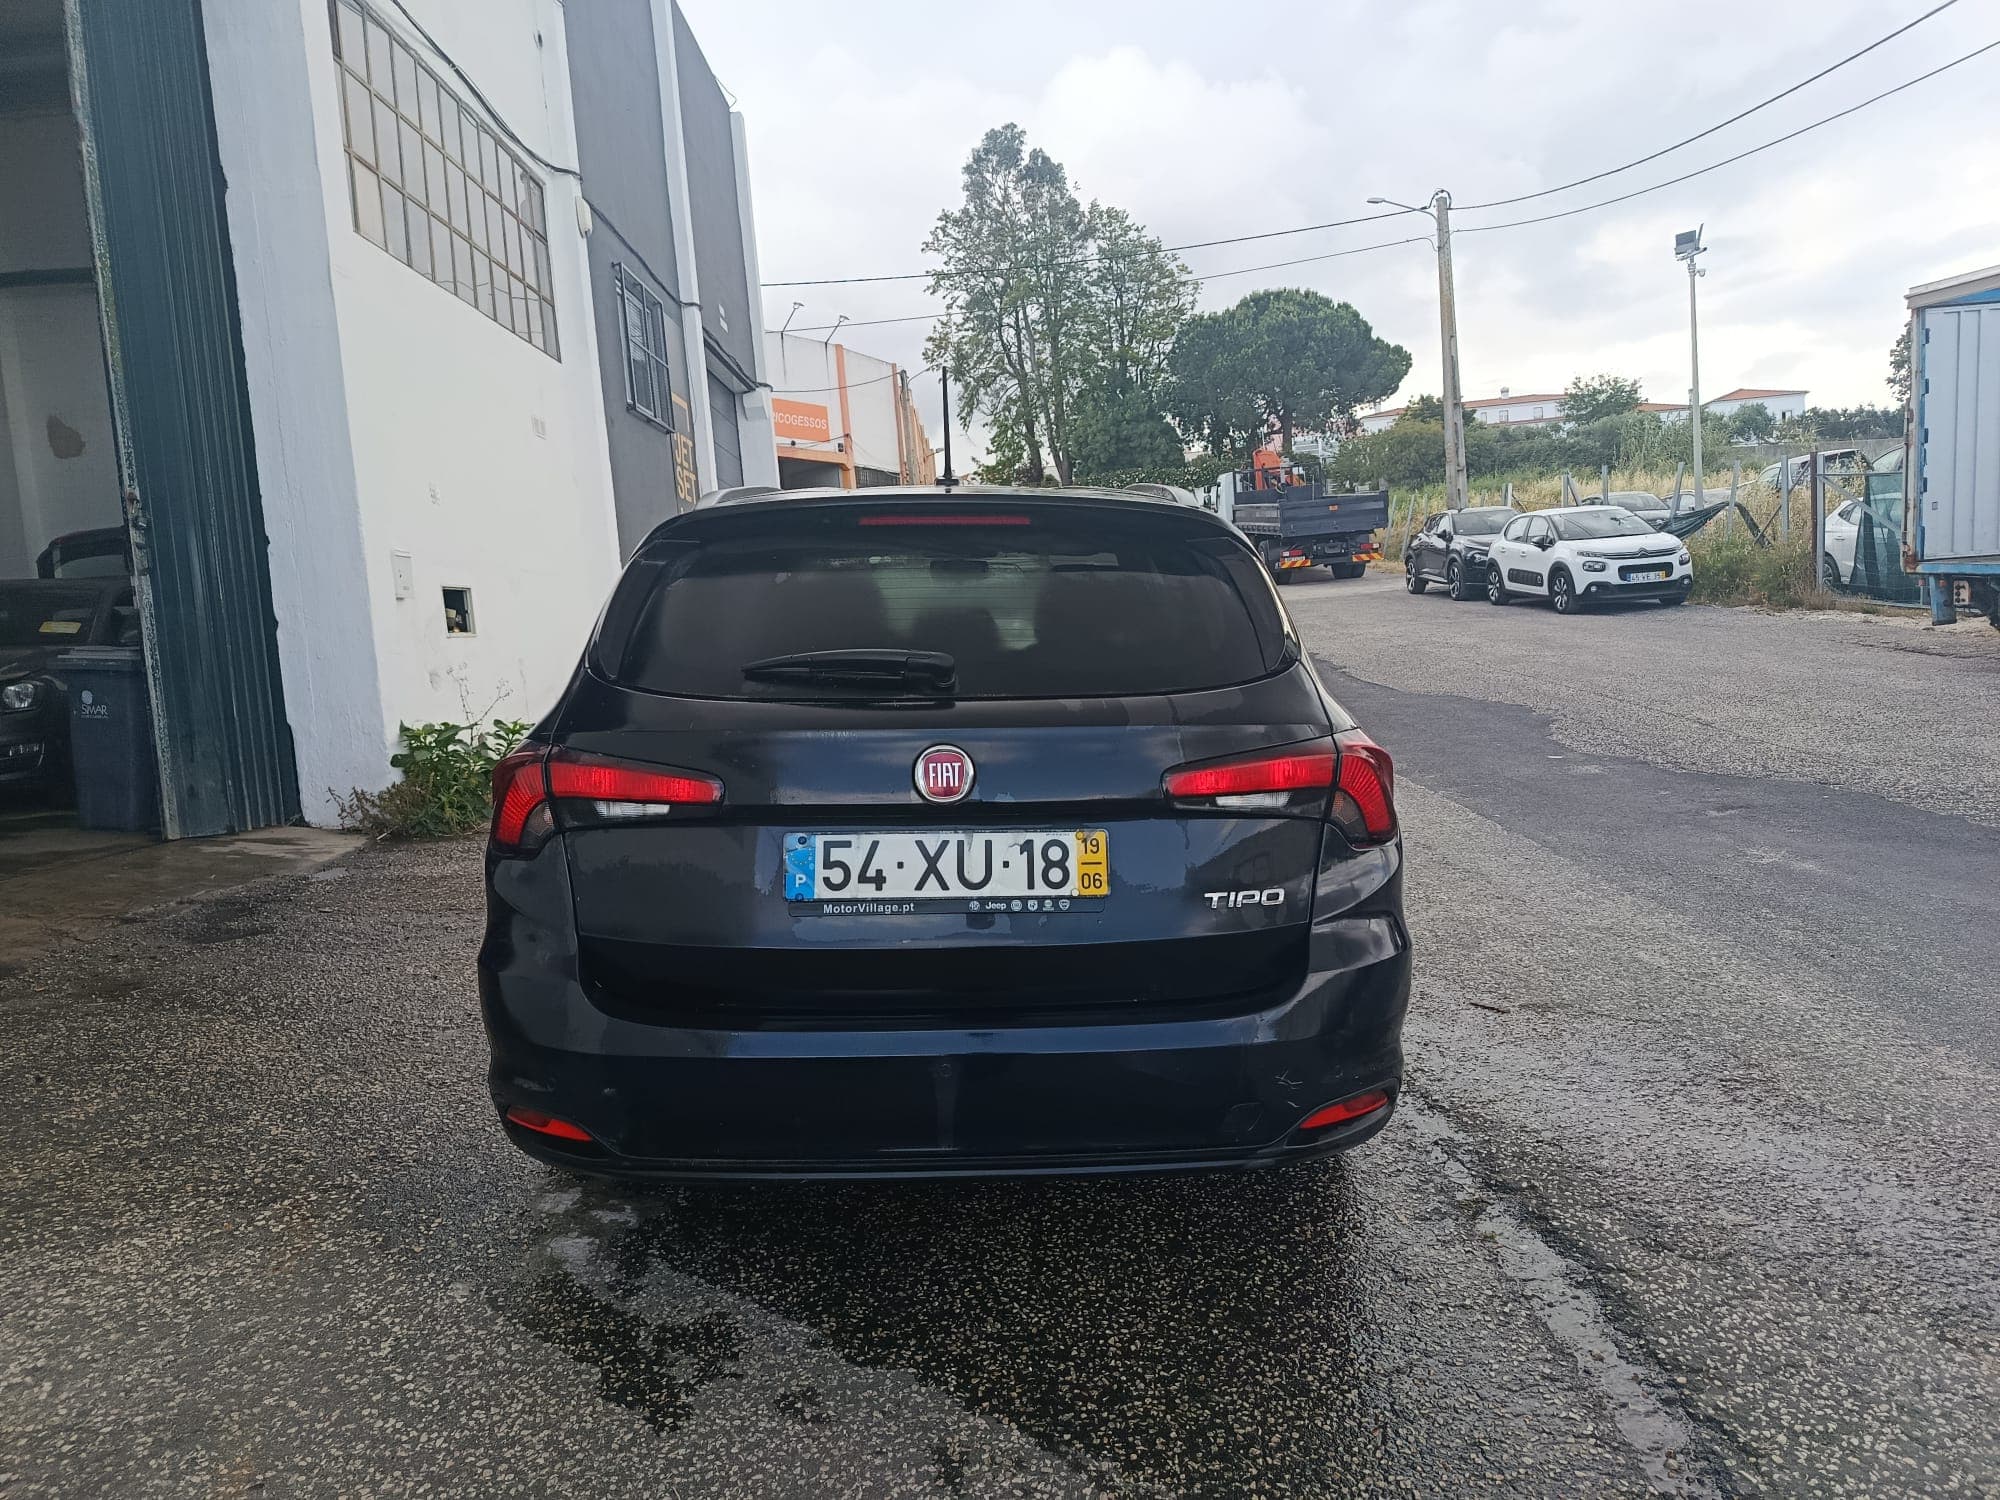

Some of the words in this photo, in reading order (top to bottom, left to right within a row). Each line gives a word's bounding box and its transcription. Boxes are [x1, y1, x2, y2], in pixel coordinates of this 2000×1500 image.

[773, 411, 828, 430] ICOGESSOS
[674, 432, 693, 472] JET
[677, 465, 697, 505] SET
[81, 704, 108, 715] SIMAR
[928, 762, 961, 787] FIAT
[1081, 837, 1100, 854] 19
[795, 873, 807, 888] P
[1081, 873, 1103, 889] 06
[985, 901, 1007, 911] Jeep
[1204, 888, 1285, 909] TIPO
[823, 902, 915, 914] MotorVillage.pt
